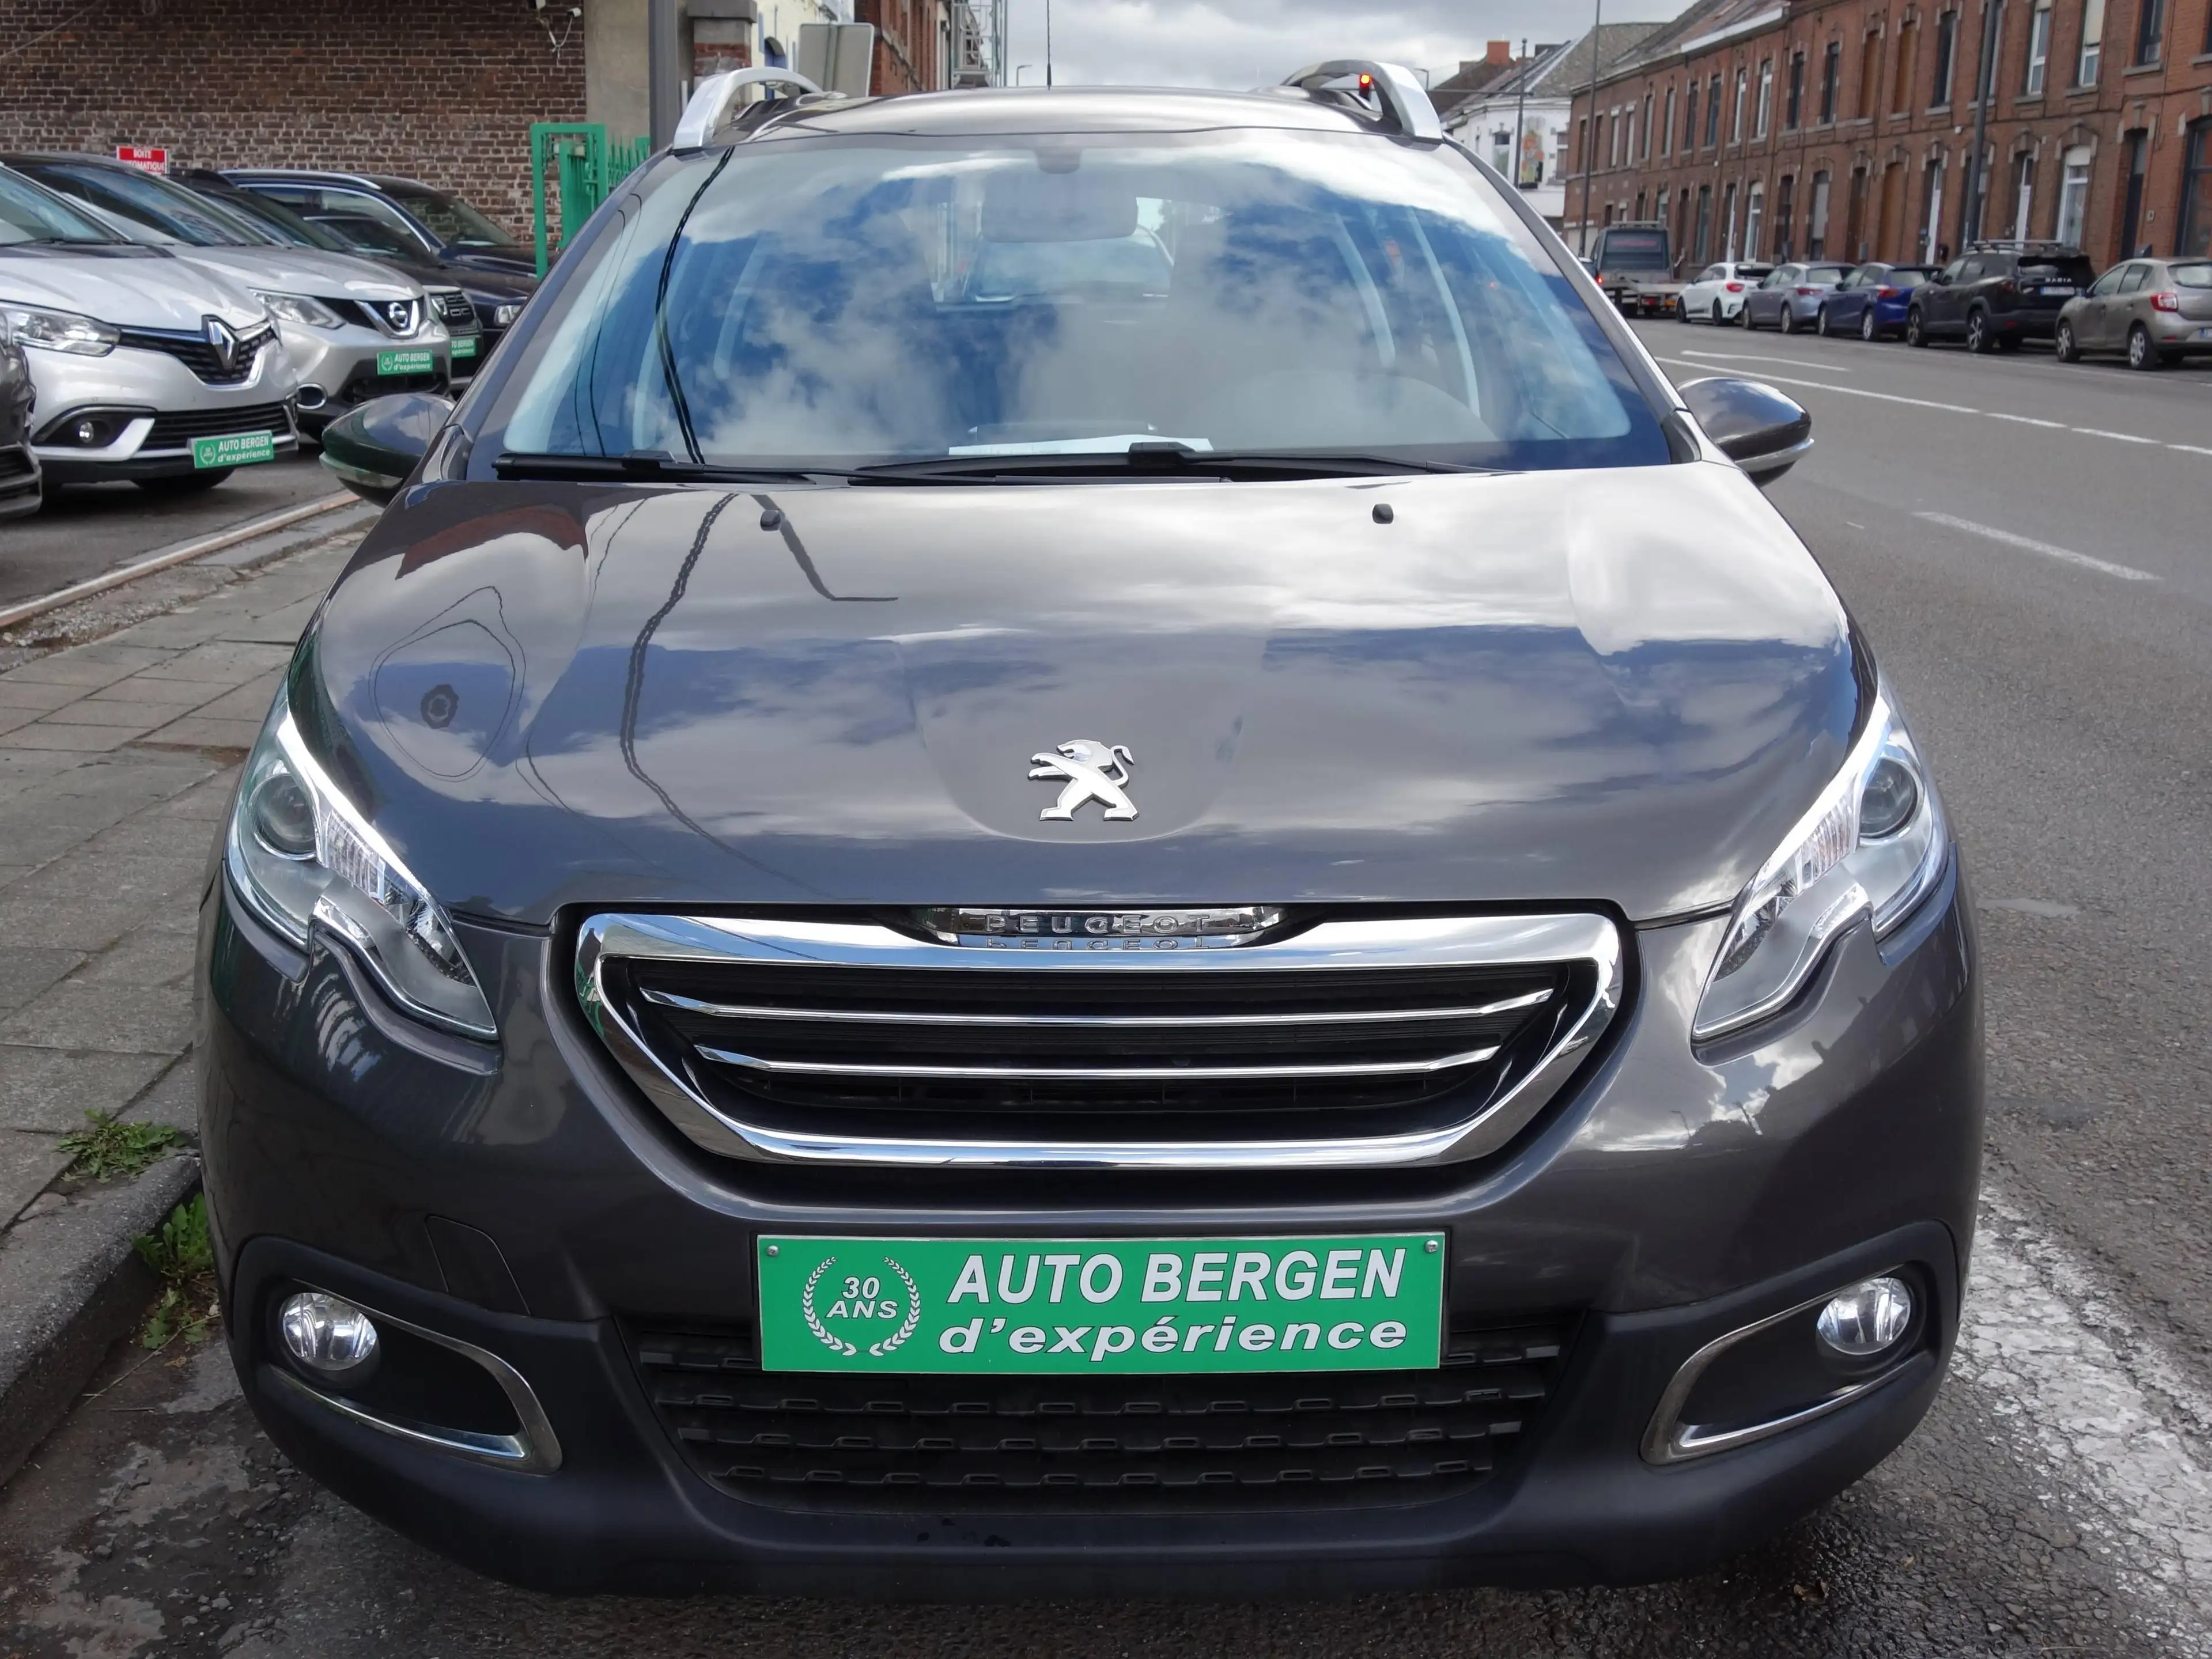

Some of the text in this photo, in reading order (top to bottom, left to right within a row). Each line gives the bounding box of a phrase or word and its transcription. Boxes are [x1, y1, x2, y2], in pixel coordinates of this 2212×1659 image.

[394, 353, 410, 362] AUTO
[218, 435, 269, 452] AUTO BERGEN
[986, 914, 1210, 934] PEUGEOT
[946, 1248, 1407, 1305] AUTO BERGEN
[841, 1276, 880, 1300] 30
[825, 1300, 899, 1319] ANS
